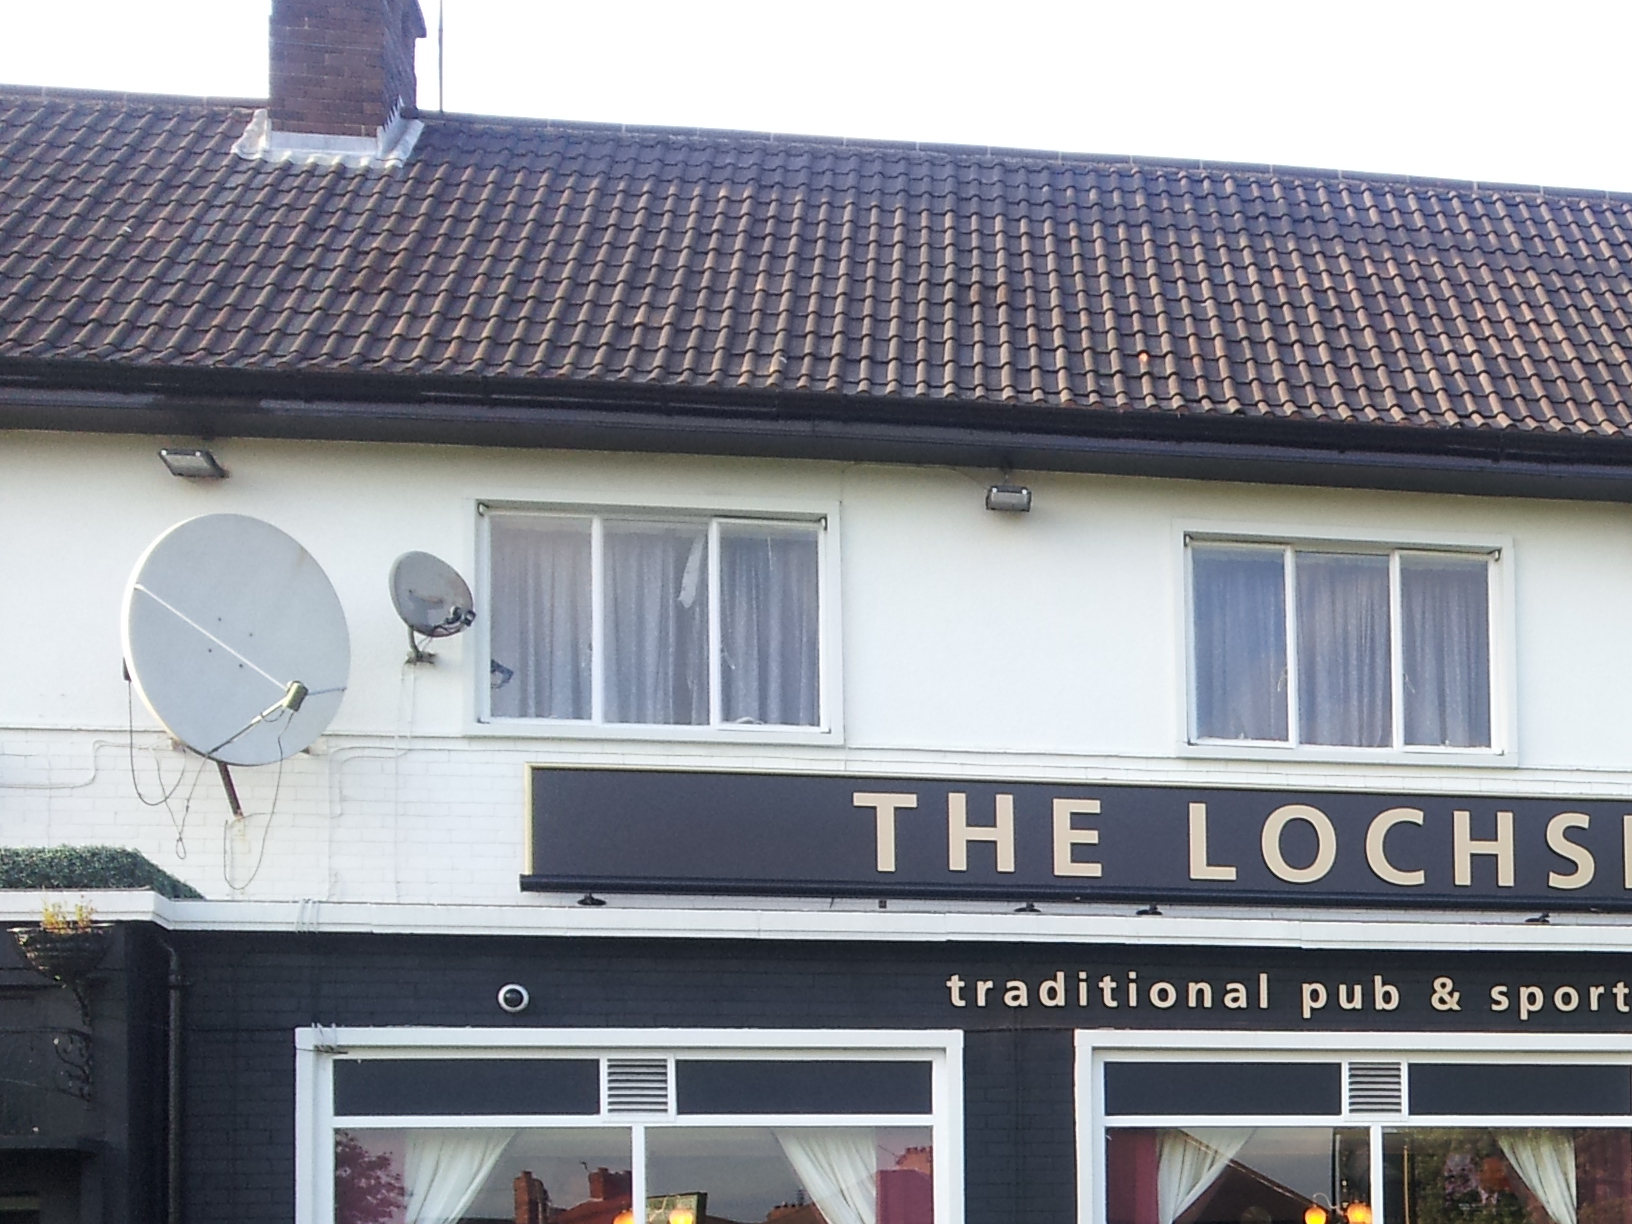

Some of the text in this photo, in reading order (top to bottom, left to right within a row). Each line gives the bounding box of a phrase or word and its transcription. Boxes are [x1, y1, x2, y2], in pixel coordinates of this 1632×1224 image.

[852, 792, 1103, 878] THE
[946, 971, 1270, 1010] traditional
[1301, 974, 1401, 1020] pub
[1430, 976, 1462, 1012] &
